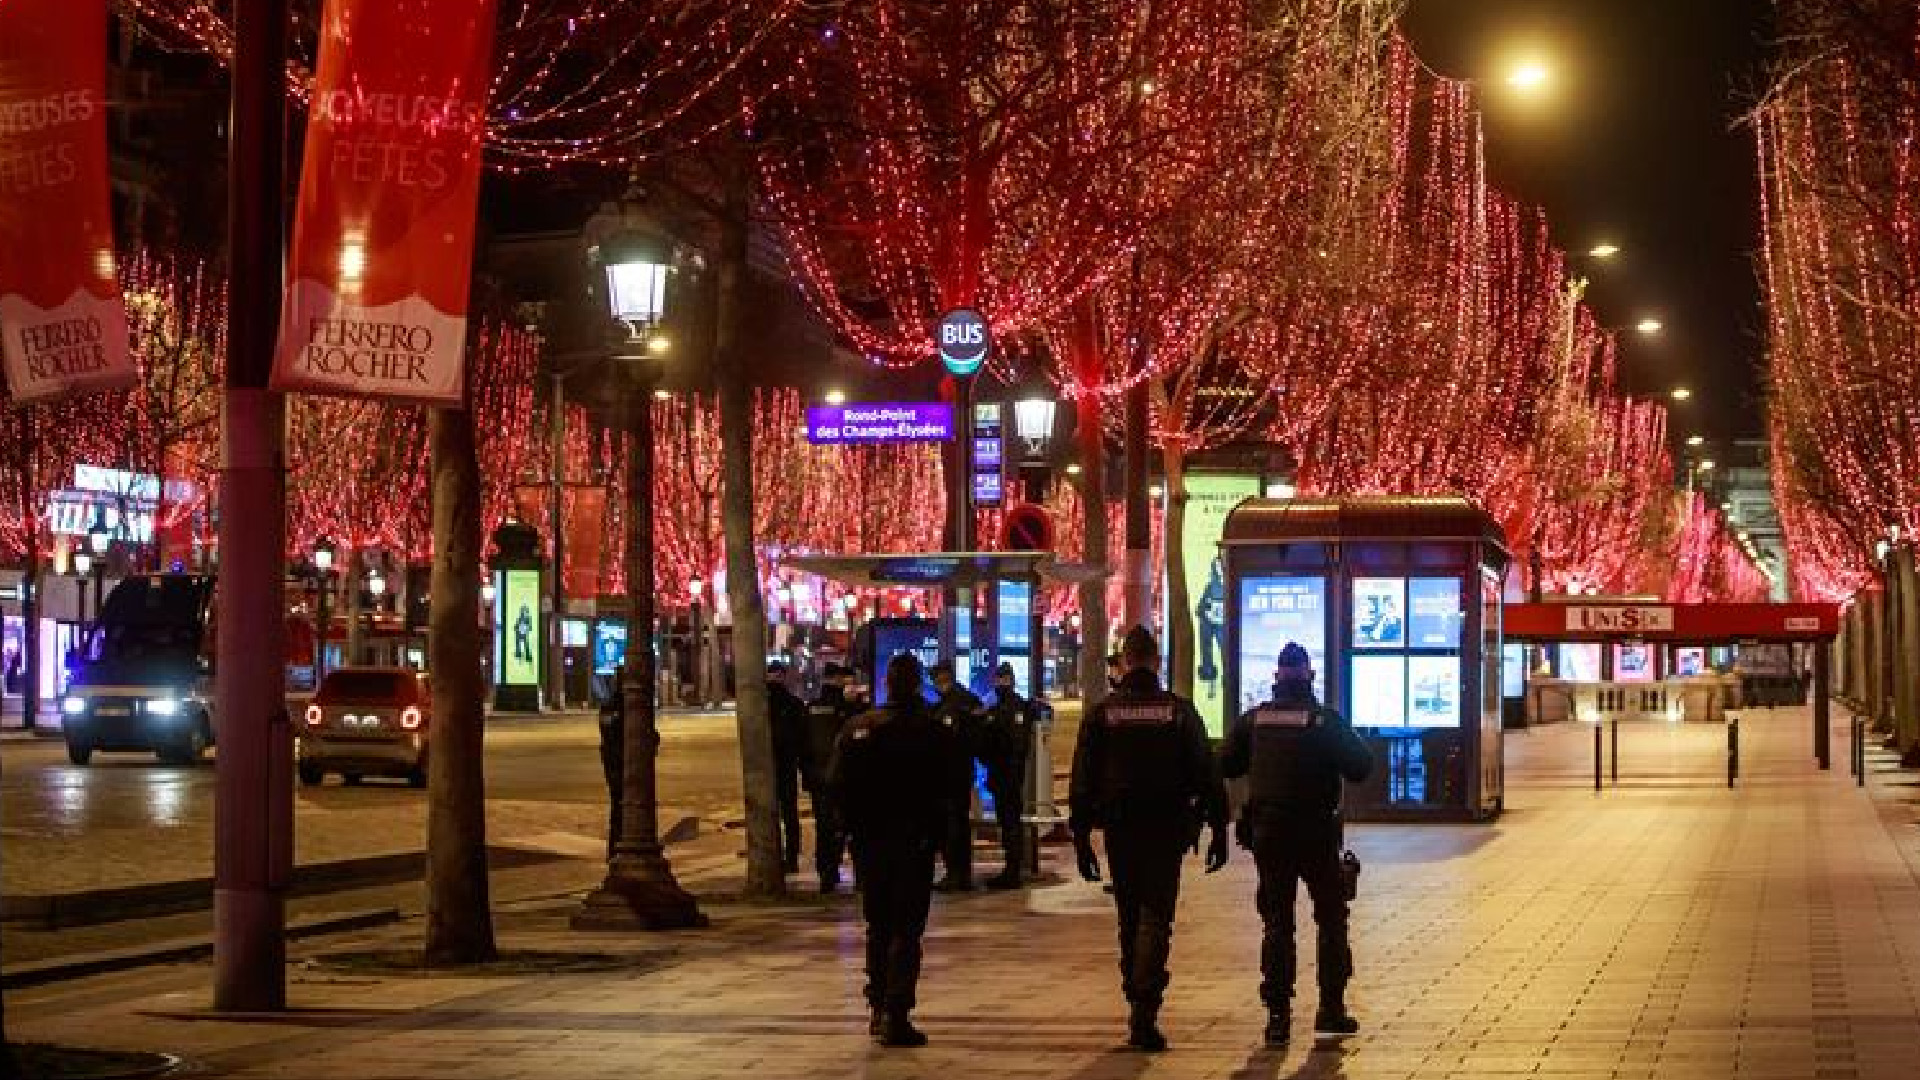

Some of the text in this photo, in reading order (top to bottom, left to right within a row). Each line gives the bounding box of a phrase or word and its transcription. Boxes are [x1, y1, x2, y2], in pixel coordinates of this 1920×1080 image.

[21, 315, 101, 354] FERRERO
[309, 318, 433, 352] FERRERO
[943, 323, 982, 343] BUS
[27, 343, 110, 381] ROCHER
[307, 346, 428, 384] ROCHER
[844, 408, 916, 421] Rond-Point
[817, 426, 838, 438] des
